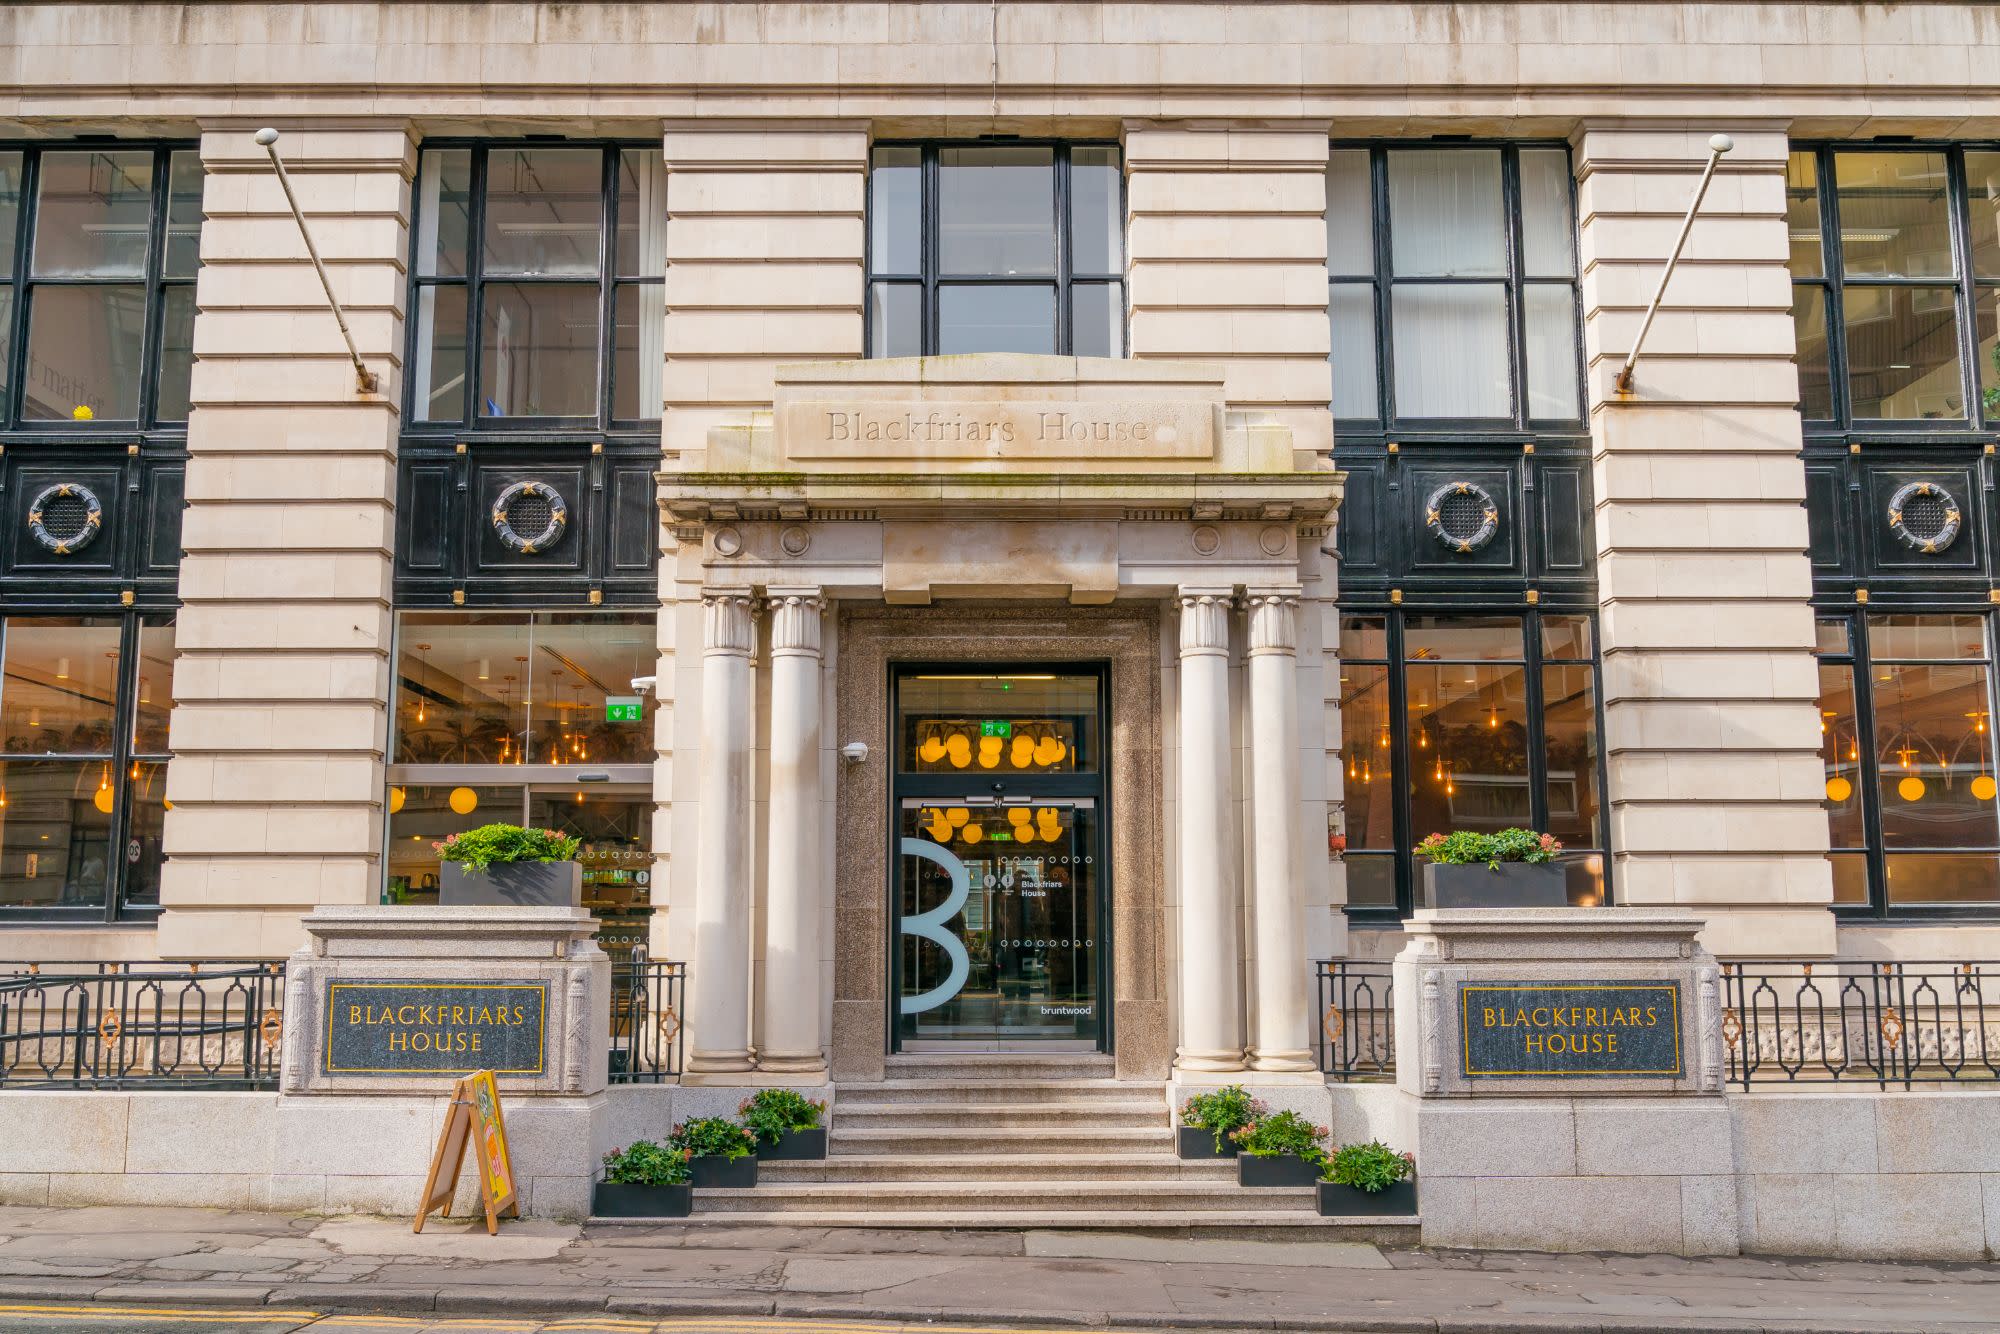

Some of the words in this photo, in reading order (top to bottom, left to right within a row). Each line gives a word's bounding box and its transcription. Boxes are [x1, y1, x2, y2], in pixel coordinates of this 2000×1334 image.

[824, 411, 1015, 442] Blackfriars
[1036, 411, 1150, 442] House
[1021, 880, 1063, 889] Blackfriars
[1021, 889, 1047, 897] House
[349, 1005, 525, 1026] BLACKFRIARS
[1040, 1005, 1092, 1015] bruntwood
[1482, 1006, 1658, 1027] BLACKFRIARS
[388, 1032, 483, 1052] HOUSE
[1525, 1033, 1618, 1054] HOUSE
